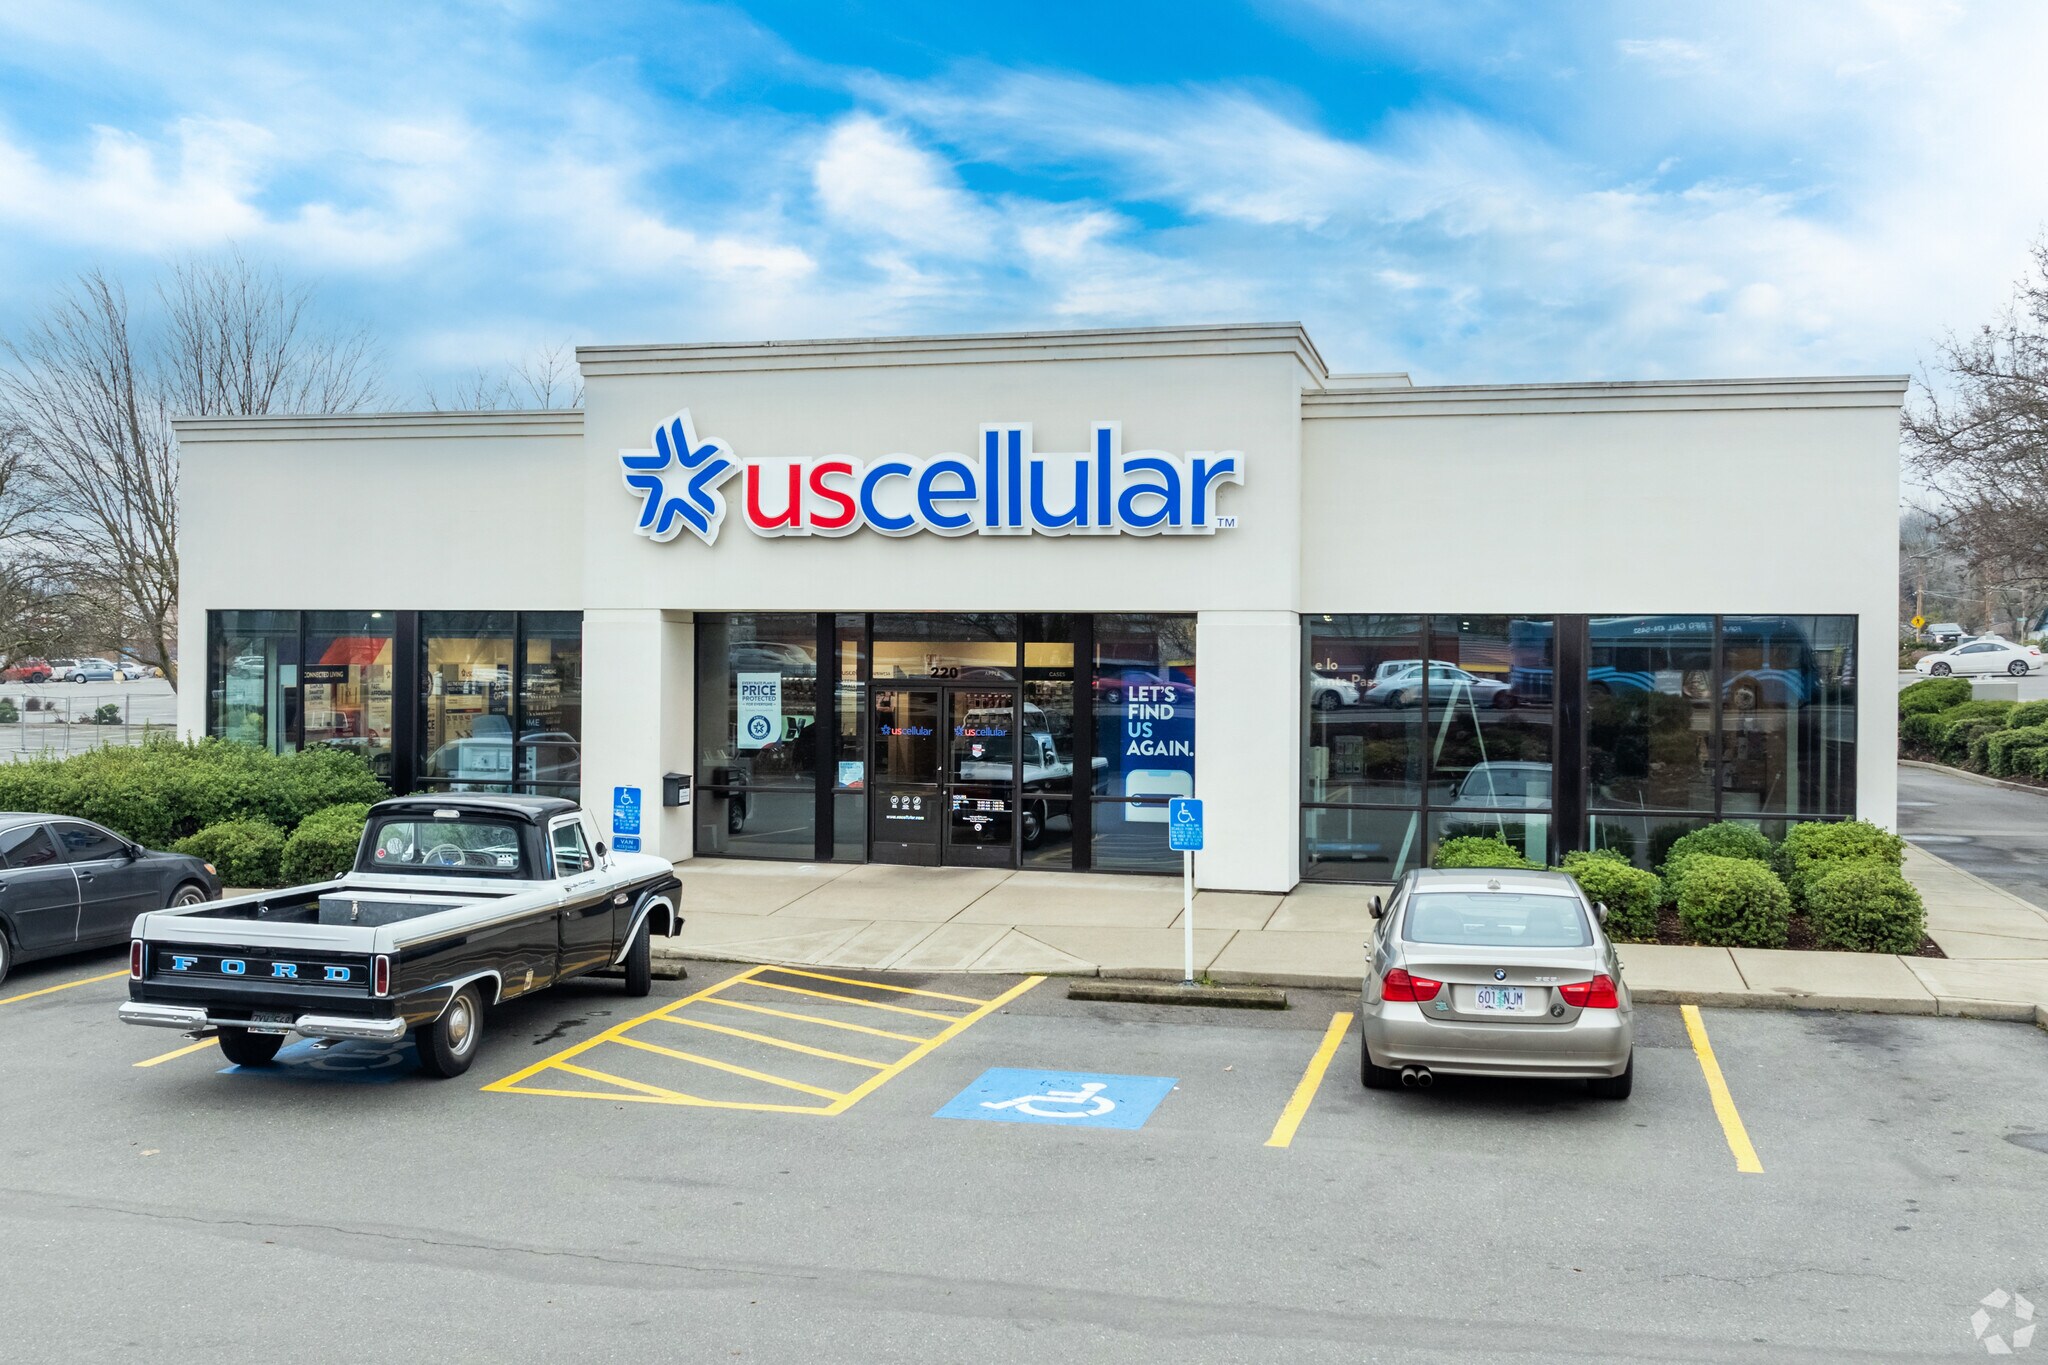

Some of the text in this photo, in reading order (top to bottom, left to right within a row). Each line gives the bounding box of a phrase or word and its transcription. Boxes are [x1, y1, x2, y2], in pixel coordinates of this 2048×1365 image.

[747, 428, 1234, 531] uscellular
[930, 667, 959, 679] 220
[742, 685, 777, 696] PRICE
[1128, 685, 1176, 702] LET'S
[1128, 703, 1175, 720] FIND
[891, 725, 933, 736] uscellular
[964, 725, 1008, 737] uscellular
[1127, 721, 1154, 738] US
[1126, 739, 1195, 757] AGAIN.
[172, 955, 351, 982] FORD
[1478, 990, 1523, 1006] 601 NJM
